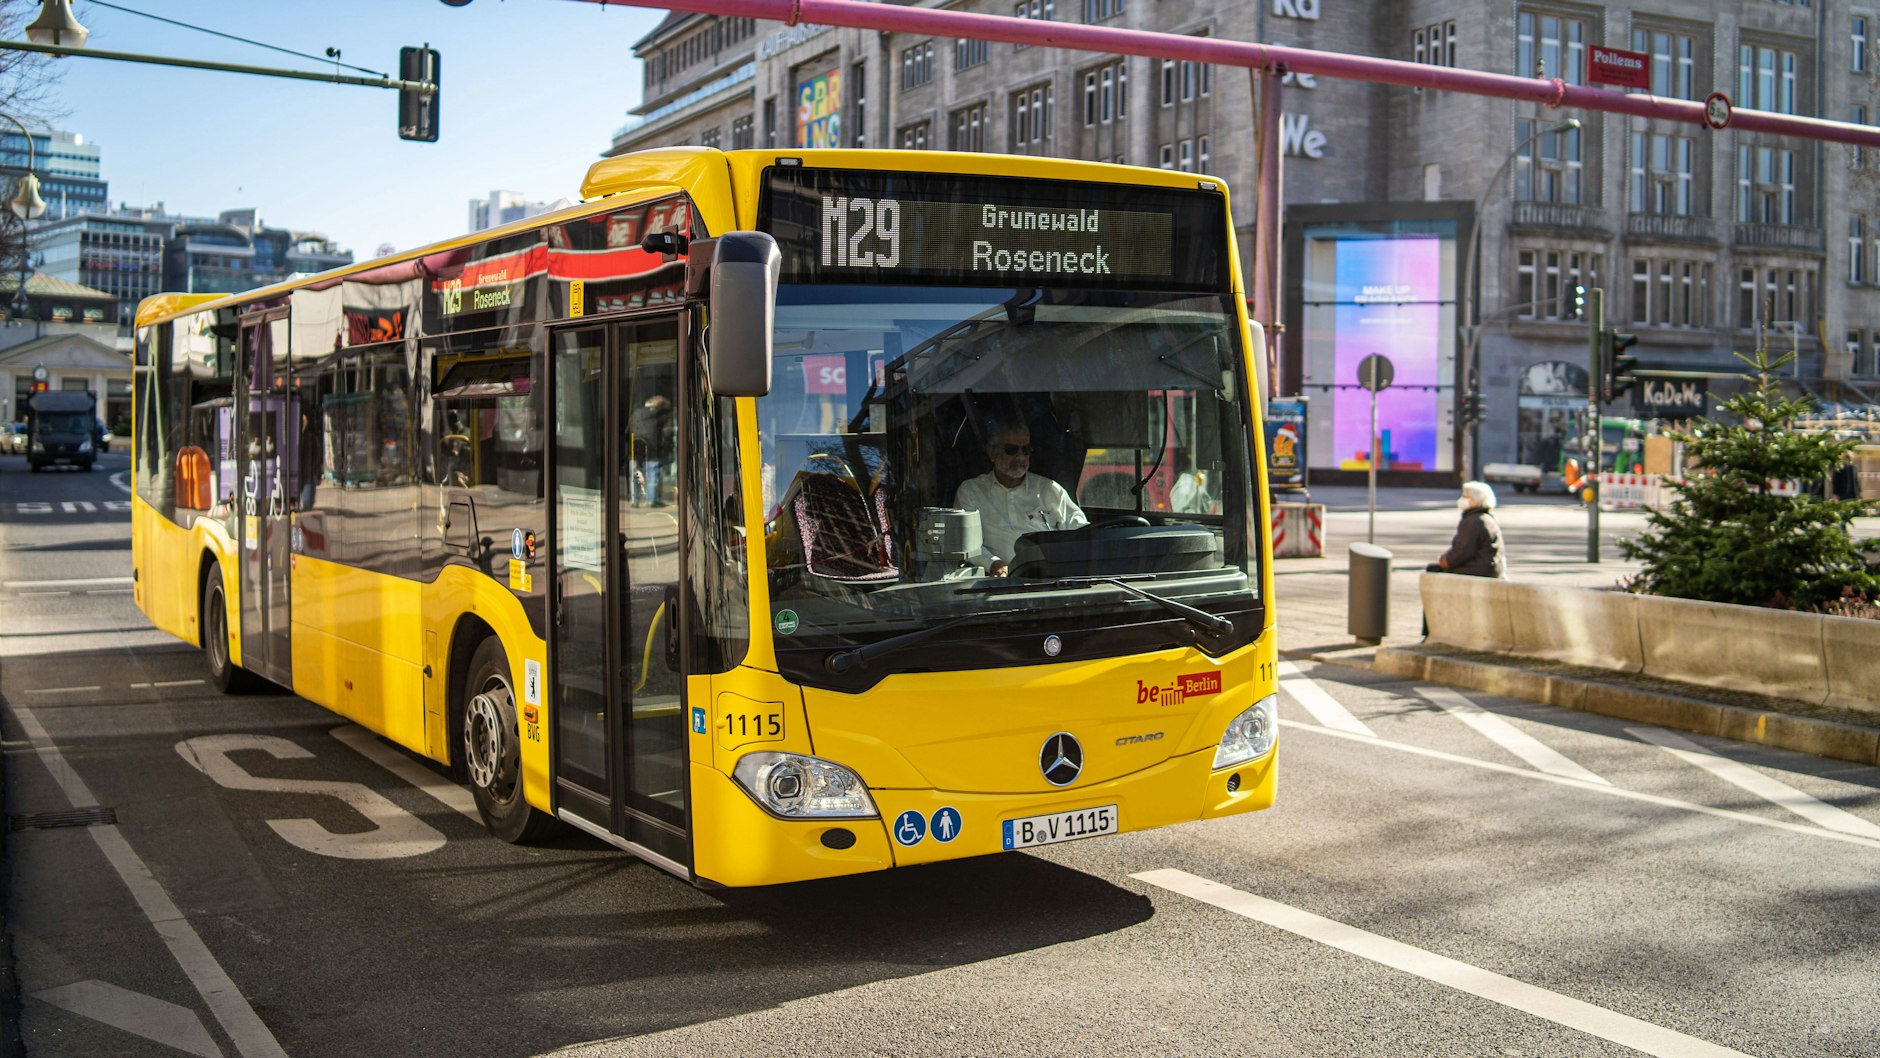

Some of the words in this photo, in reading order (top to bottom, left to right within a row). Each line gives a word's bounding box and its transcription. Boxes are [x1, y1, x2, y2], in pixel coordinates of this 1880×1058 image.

[1593, 50, 1643, 69] Pollems
[1282, 114, 1327, 159] We
[982, 204, 1099, 232] Grunewald
[822, 196, 900, 268] M29
[973, 240, 1110, 274] Roseneck
[478, 269, 507, 285] Grunewald
[443, 278, 462, 316] M29
[473, 287, 511, 311] Roseneck
[1643, 380, 1702, 407] KaDeWe
[783, 611, 790, 622] 4
[1137, 680, 1160, 704] be
[1185, 677, 1218, 693] Berlin
[527, 722, 540, 742] BVG
[726, 713, 780, 737] 1115
[1115, 732, 1165, 746] CITARO
[1022, 821, 1035, 844] B
[1048, 817, 1060, 839] V
[1065, 809, 1109, 837] 1115
